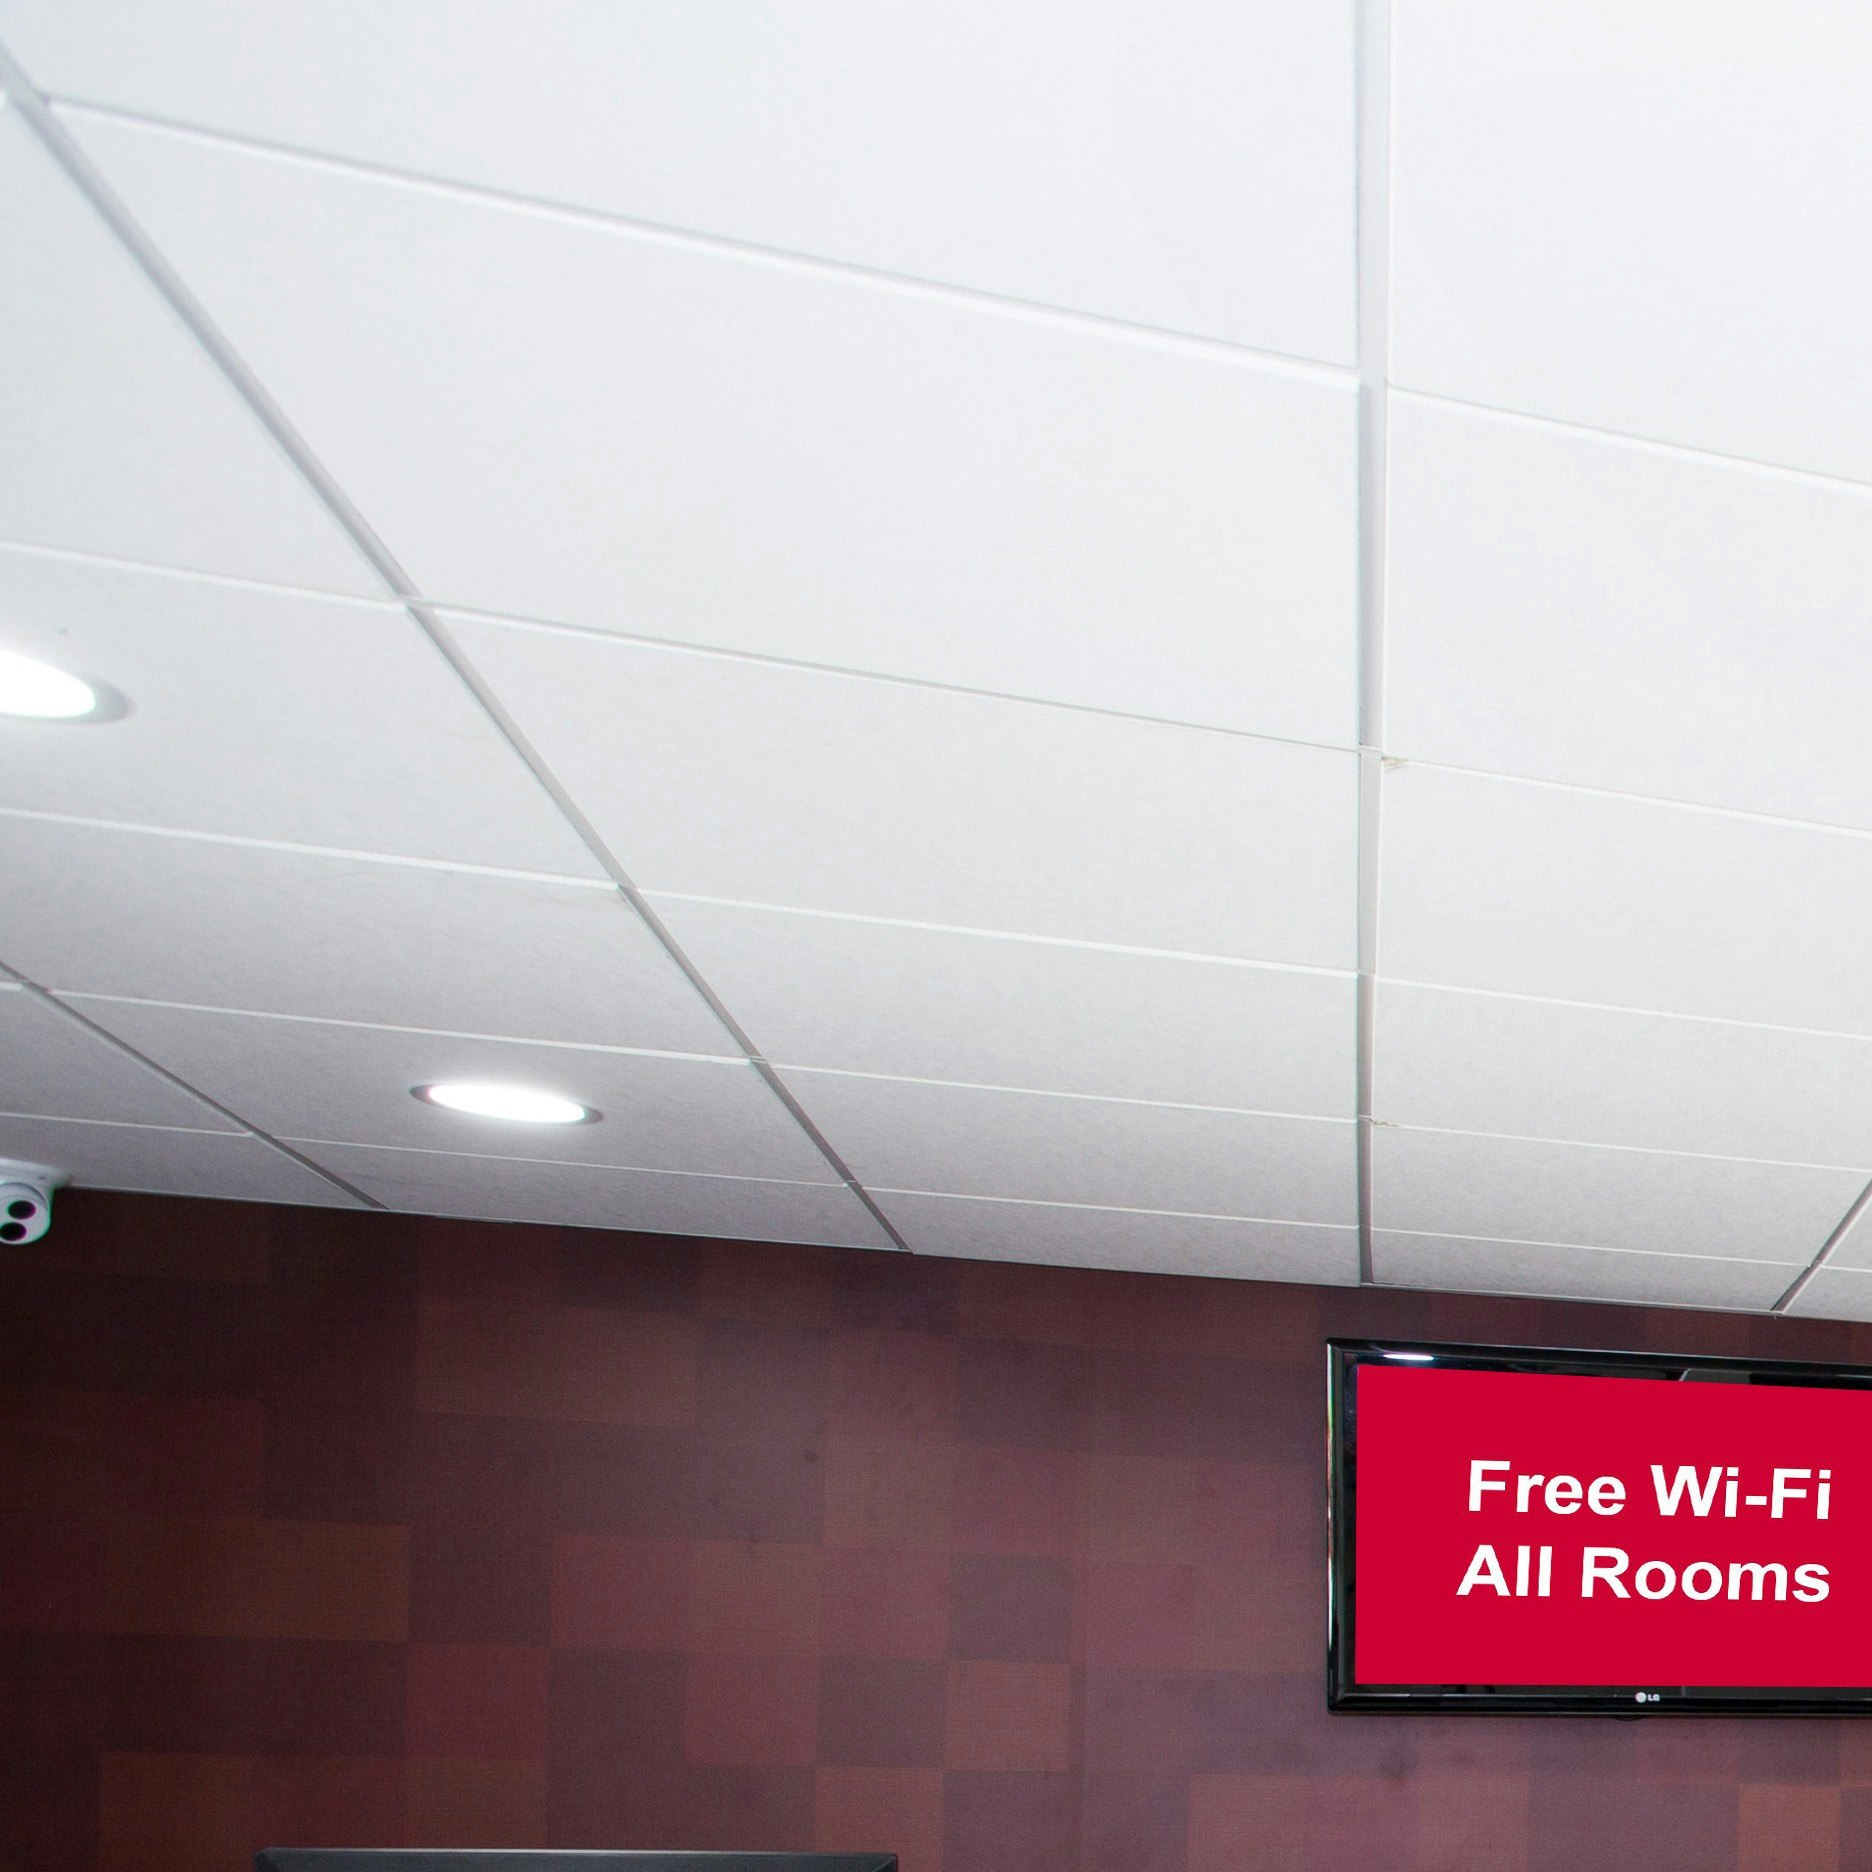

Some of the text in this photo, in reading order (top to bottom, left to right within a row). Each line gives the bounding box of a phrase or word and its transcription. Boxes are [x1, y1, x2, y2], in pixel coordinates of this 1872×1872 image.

[1468, 1460, 1831, 1520] Free Wi-Fi
[1456, 1545, 1830, 1603] All Rooms
